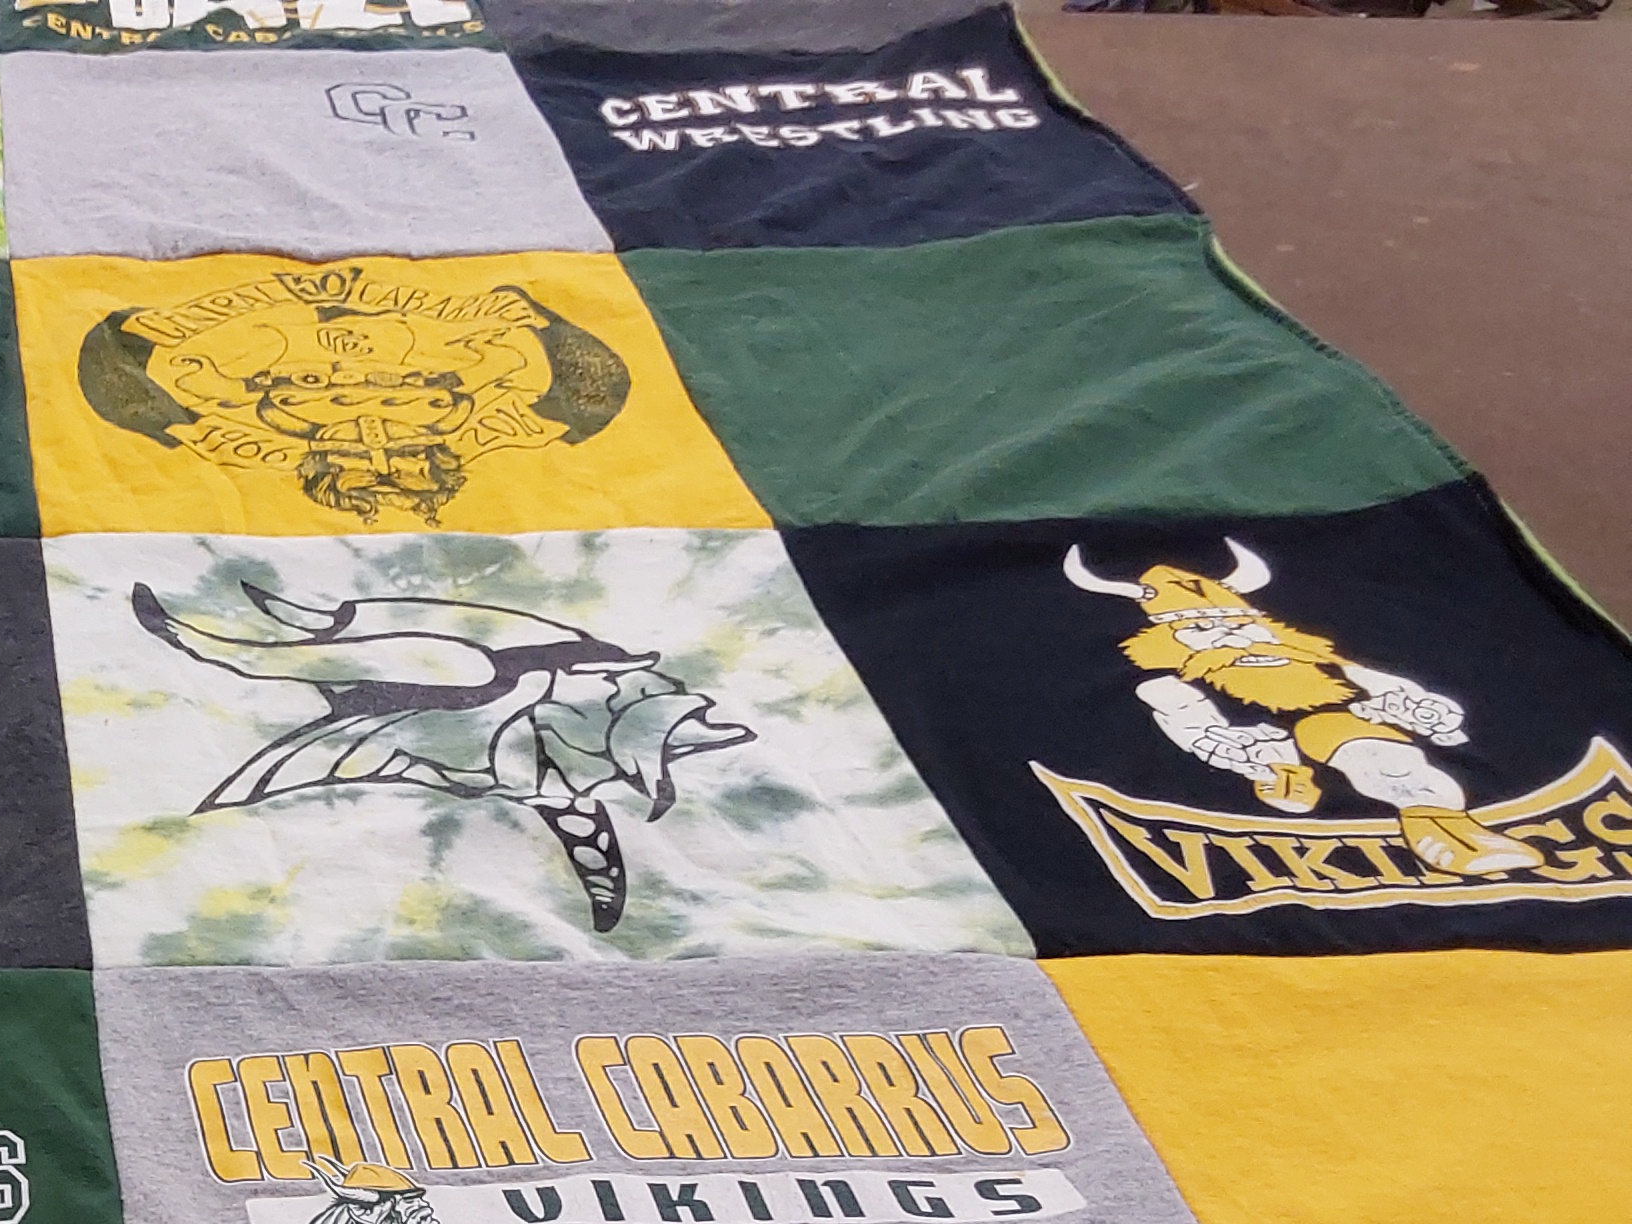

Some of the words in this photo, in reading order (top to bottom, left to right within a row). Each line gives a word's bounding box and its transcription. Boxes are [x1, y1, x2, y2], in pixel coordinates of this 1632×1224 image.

[599, 67, 1025, 128] CENTRAL
[610, 107, 1041, 151] WRESTLING
[292, 272, 347, 297] 50
[191, 426, 288, 464] 1966
[459, 399, 545, 447] 2016
[1099, 790, 1632, 899] VIKIG
[185, 1036, 595, 1184] CENTRAL
[576, 1024, 1074, 1161] CABARRUS
[504, 1176, 1043, 1224] VIKINGS
